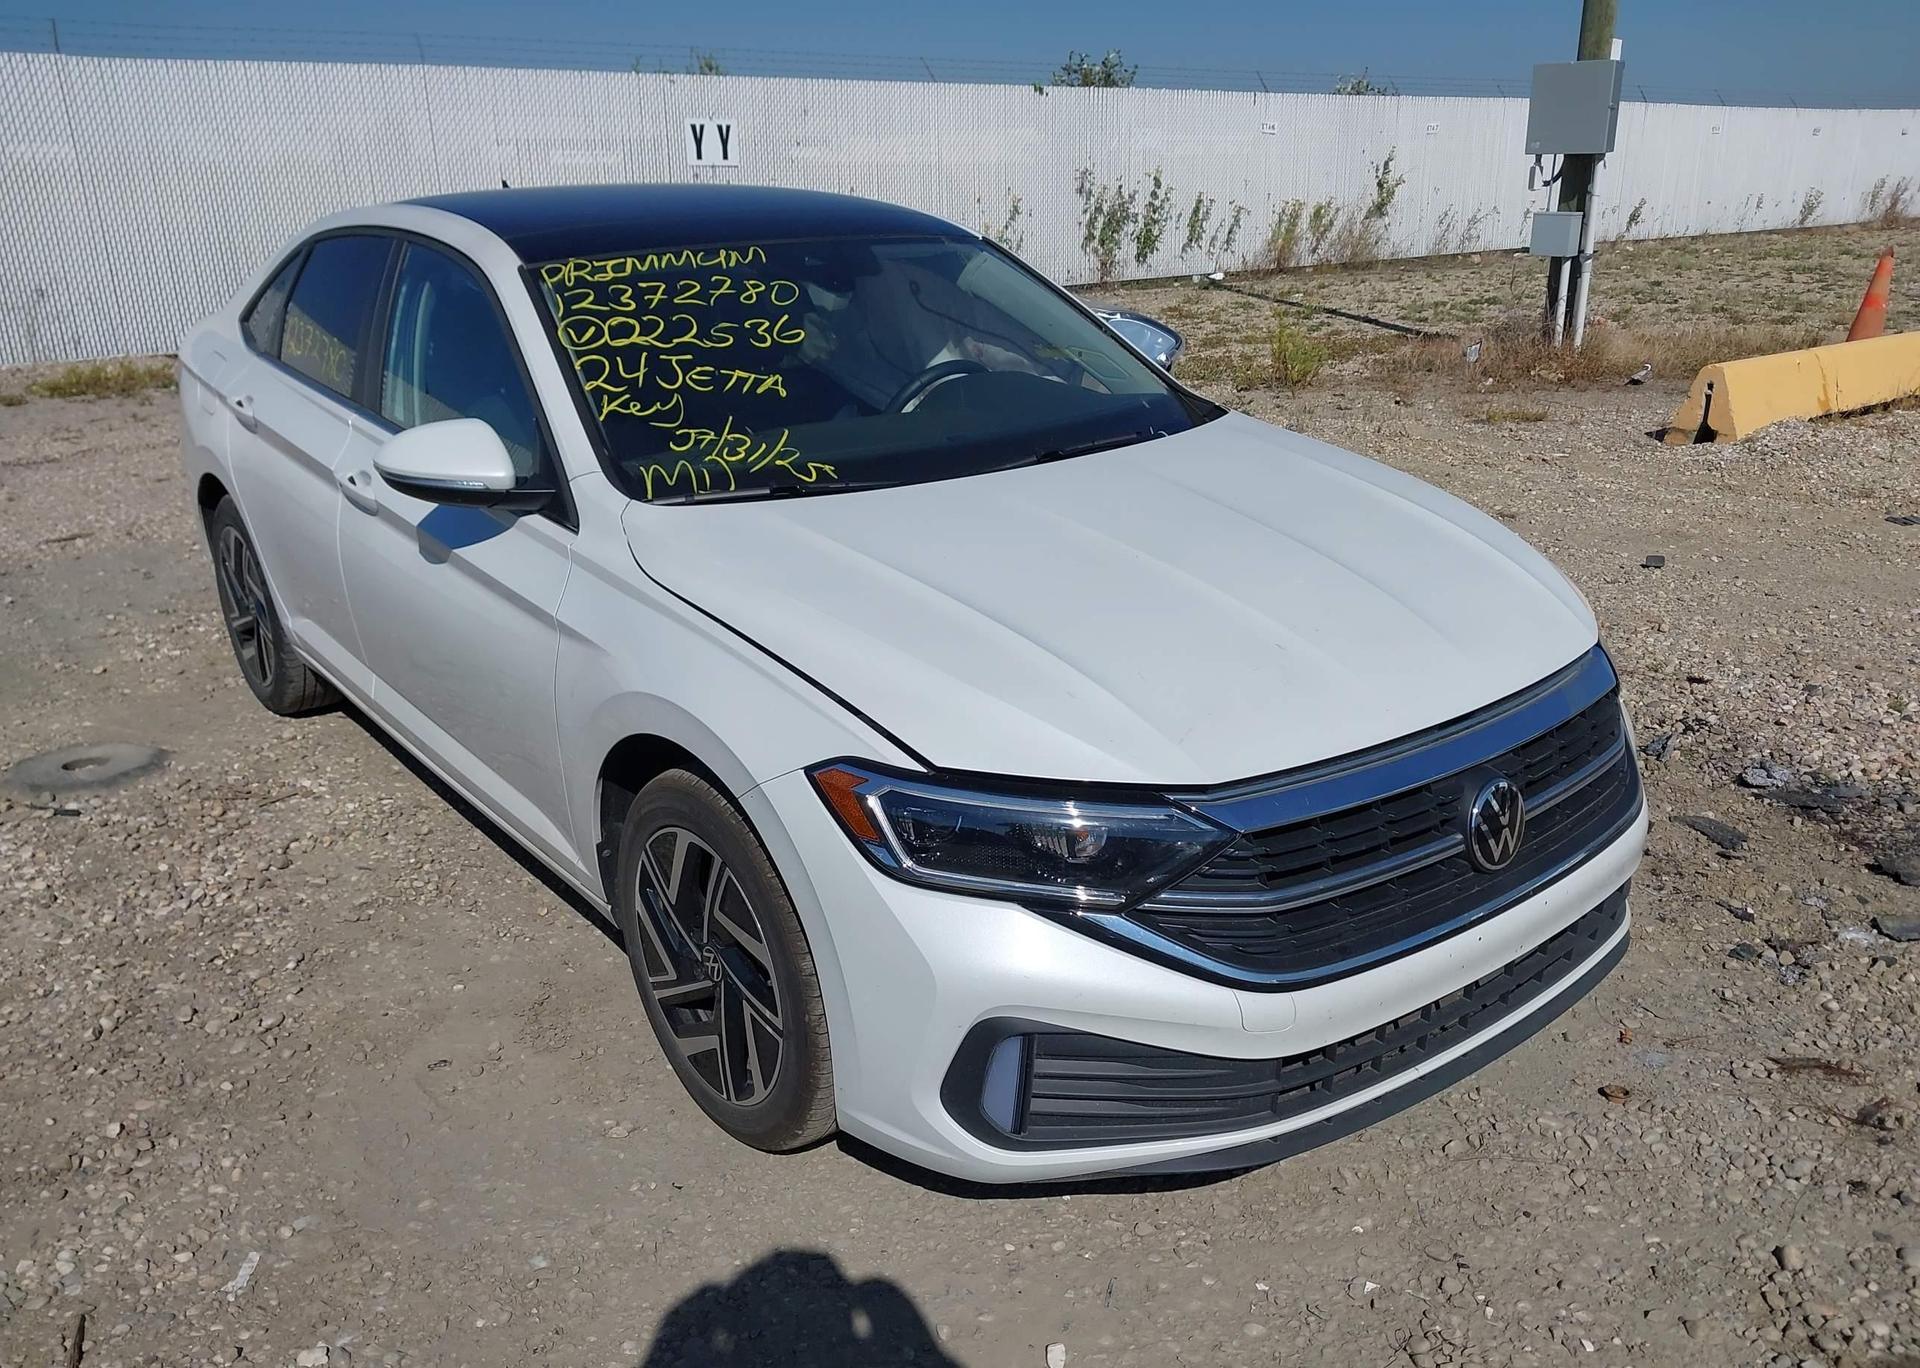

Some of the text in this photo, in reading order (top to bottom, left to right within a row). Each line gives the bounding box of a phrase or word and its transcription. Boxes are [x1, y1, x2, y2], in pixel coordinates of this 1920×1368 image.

[555, 275, 799, 317] 12372780
[574, 352, 787, 398] 24 JETTA
[1470, 780, 1524, 869] VW
